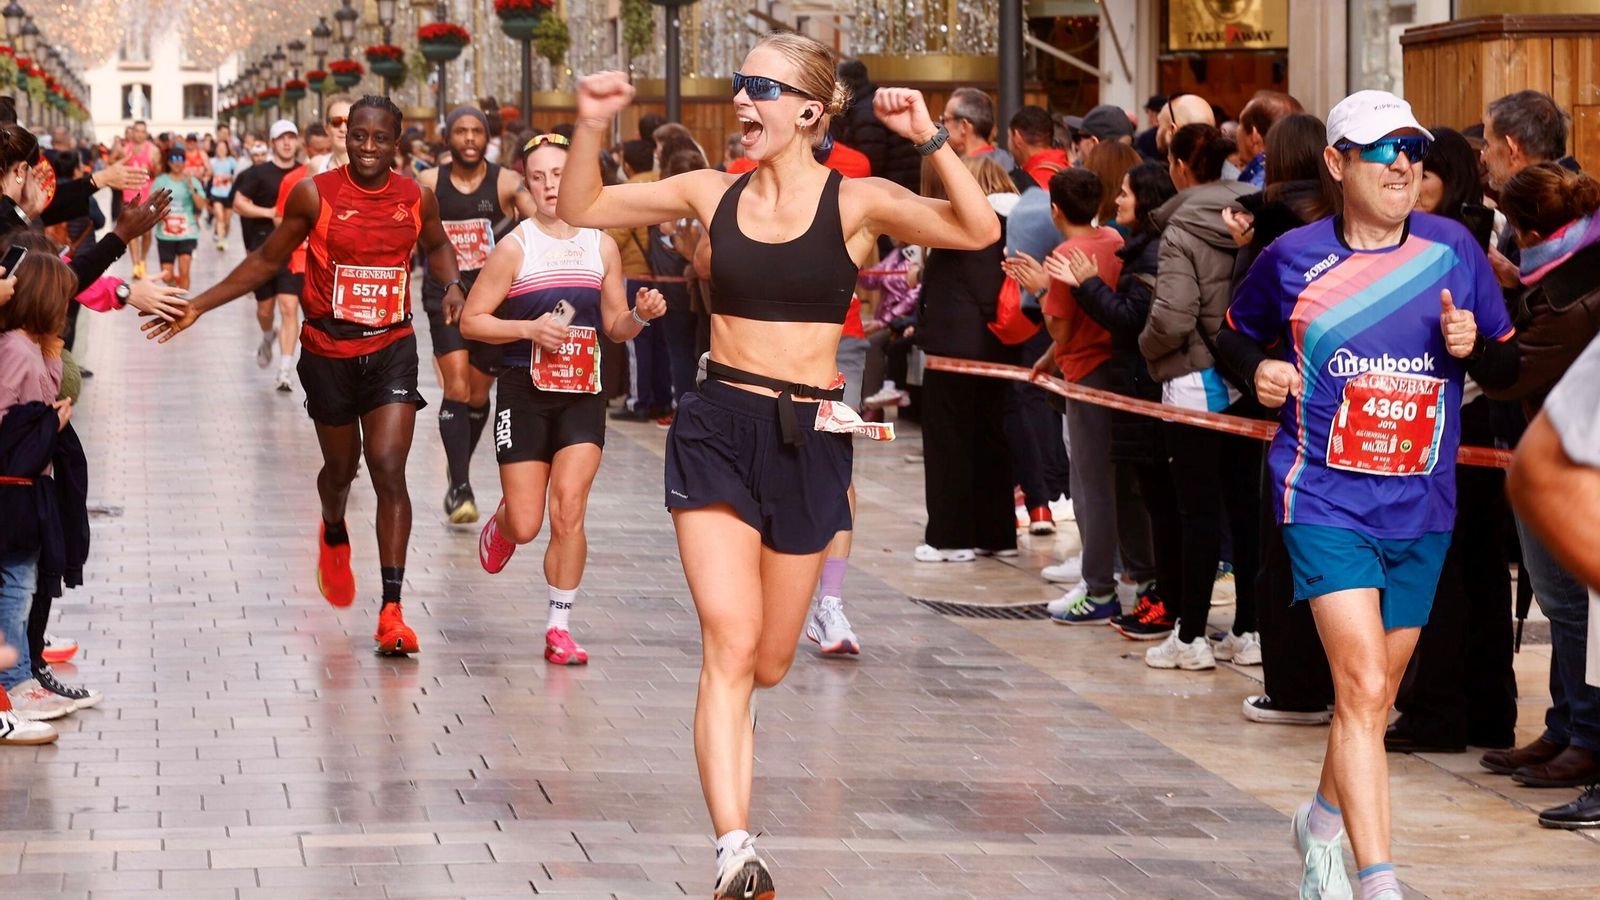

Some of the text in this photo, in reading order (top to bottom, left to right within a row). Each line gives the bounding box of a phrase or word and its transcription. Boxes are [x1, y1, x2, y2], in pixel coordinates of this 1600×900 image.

[1185, 30, 1273, 43] TAKE AWAY
[355, 269, 397, 280] GENERALI
[352, 282, 388, 298] 5574
[552, 342, 582, 356] 397
[1334, 351, 1436, 376] Insubook
[1368, 375, 1437, 396] GENERALI
[1362, 396, 1418, 422] 4360
[497, 408, 513, 453] PSRC
[1377, 420, 1397, 430] JOTA
